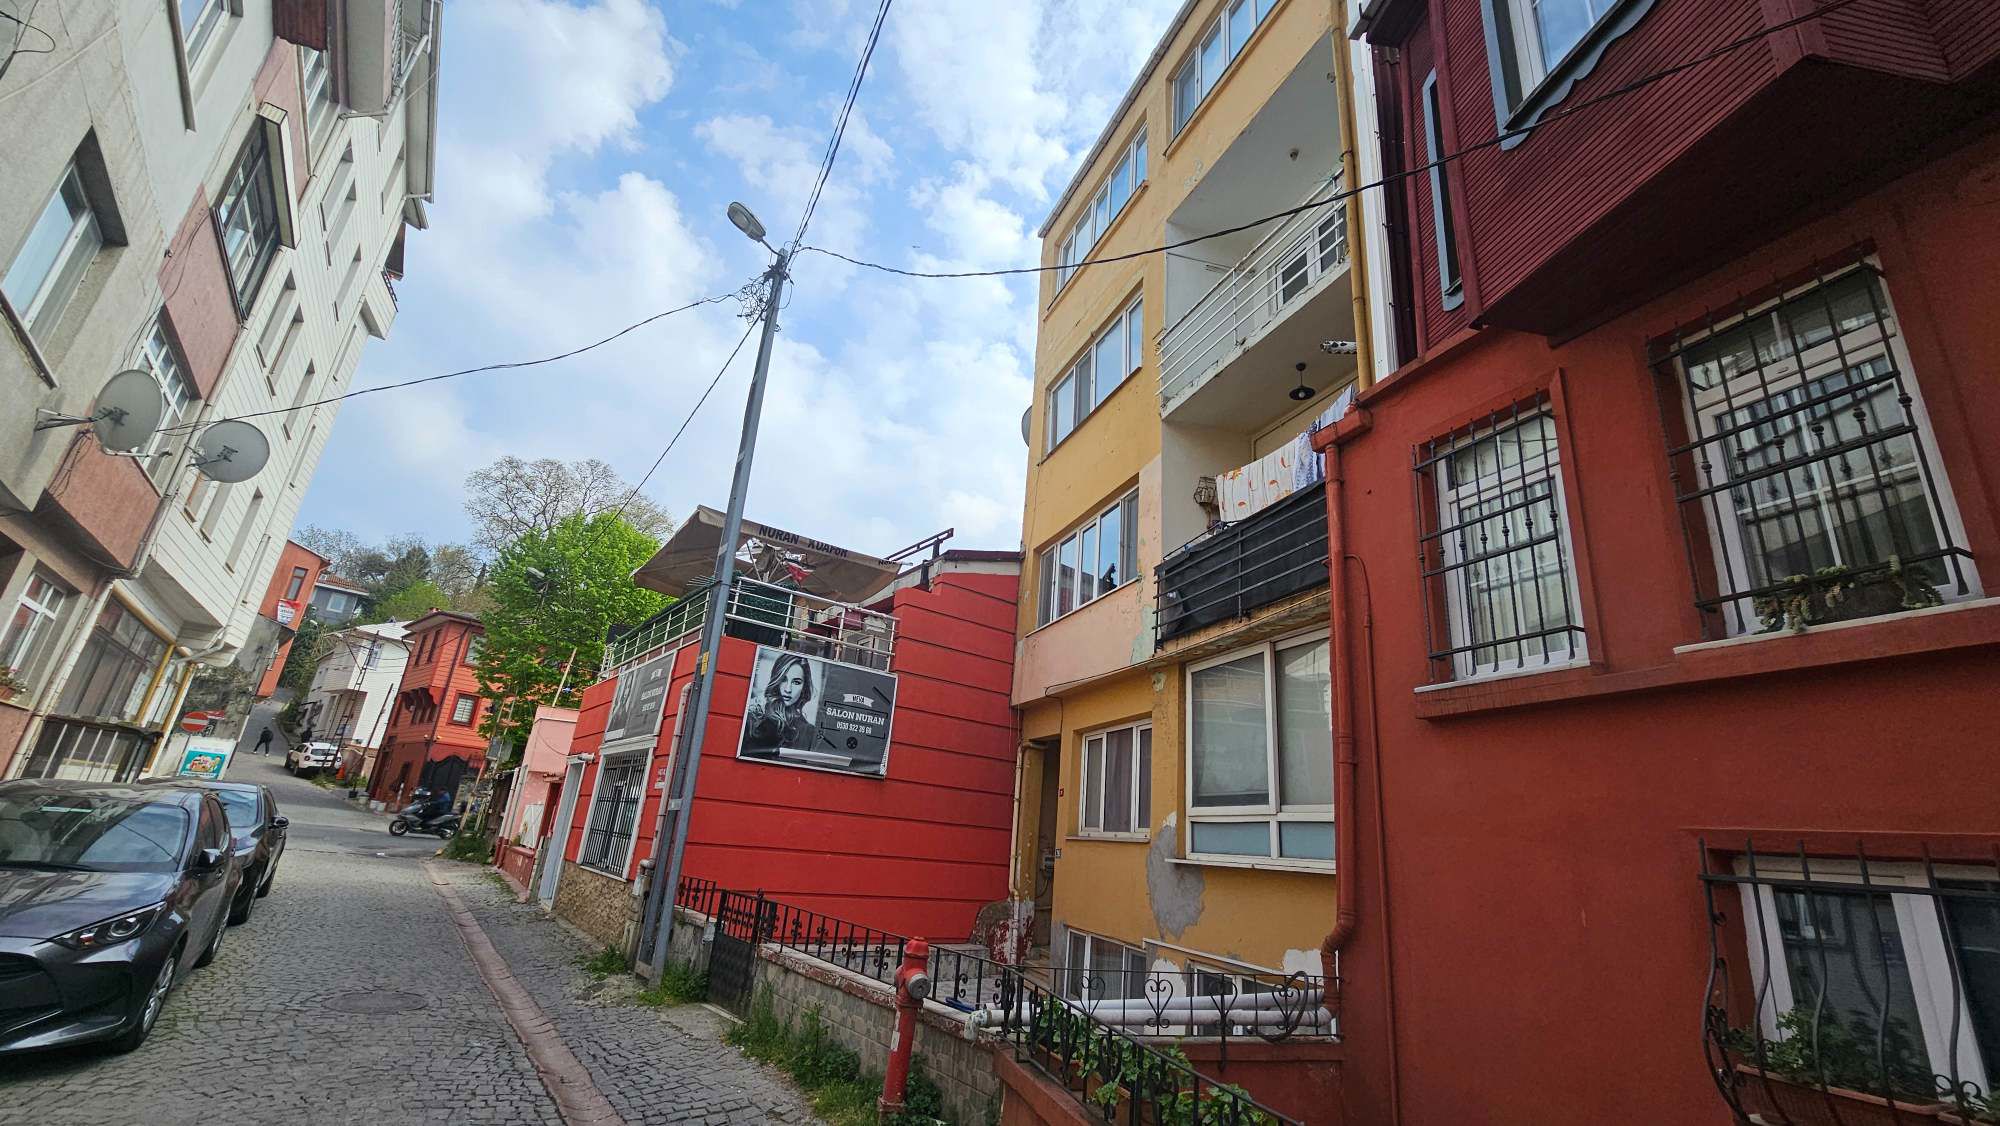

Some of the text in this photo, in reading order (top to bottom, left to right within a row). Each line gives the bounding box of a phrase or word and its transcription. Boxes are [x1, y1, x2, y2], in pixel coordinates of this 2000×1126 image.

[759, 525, 799, 545] NURAN
[826, 707, 885, 726] SALON NURAN
